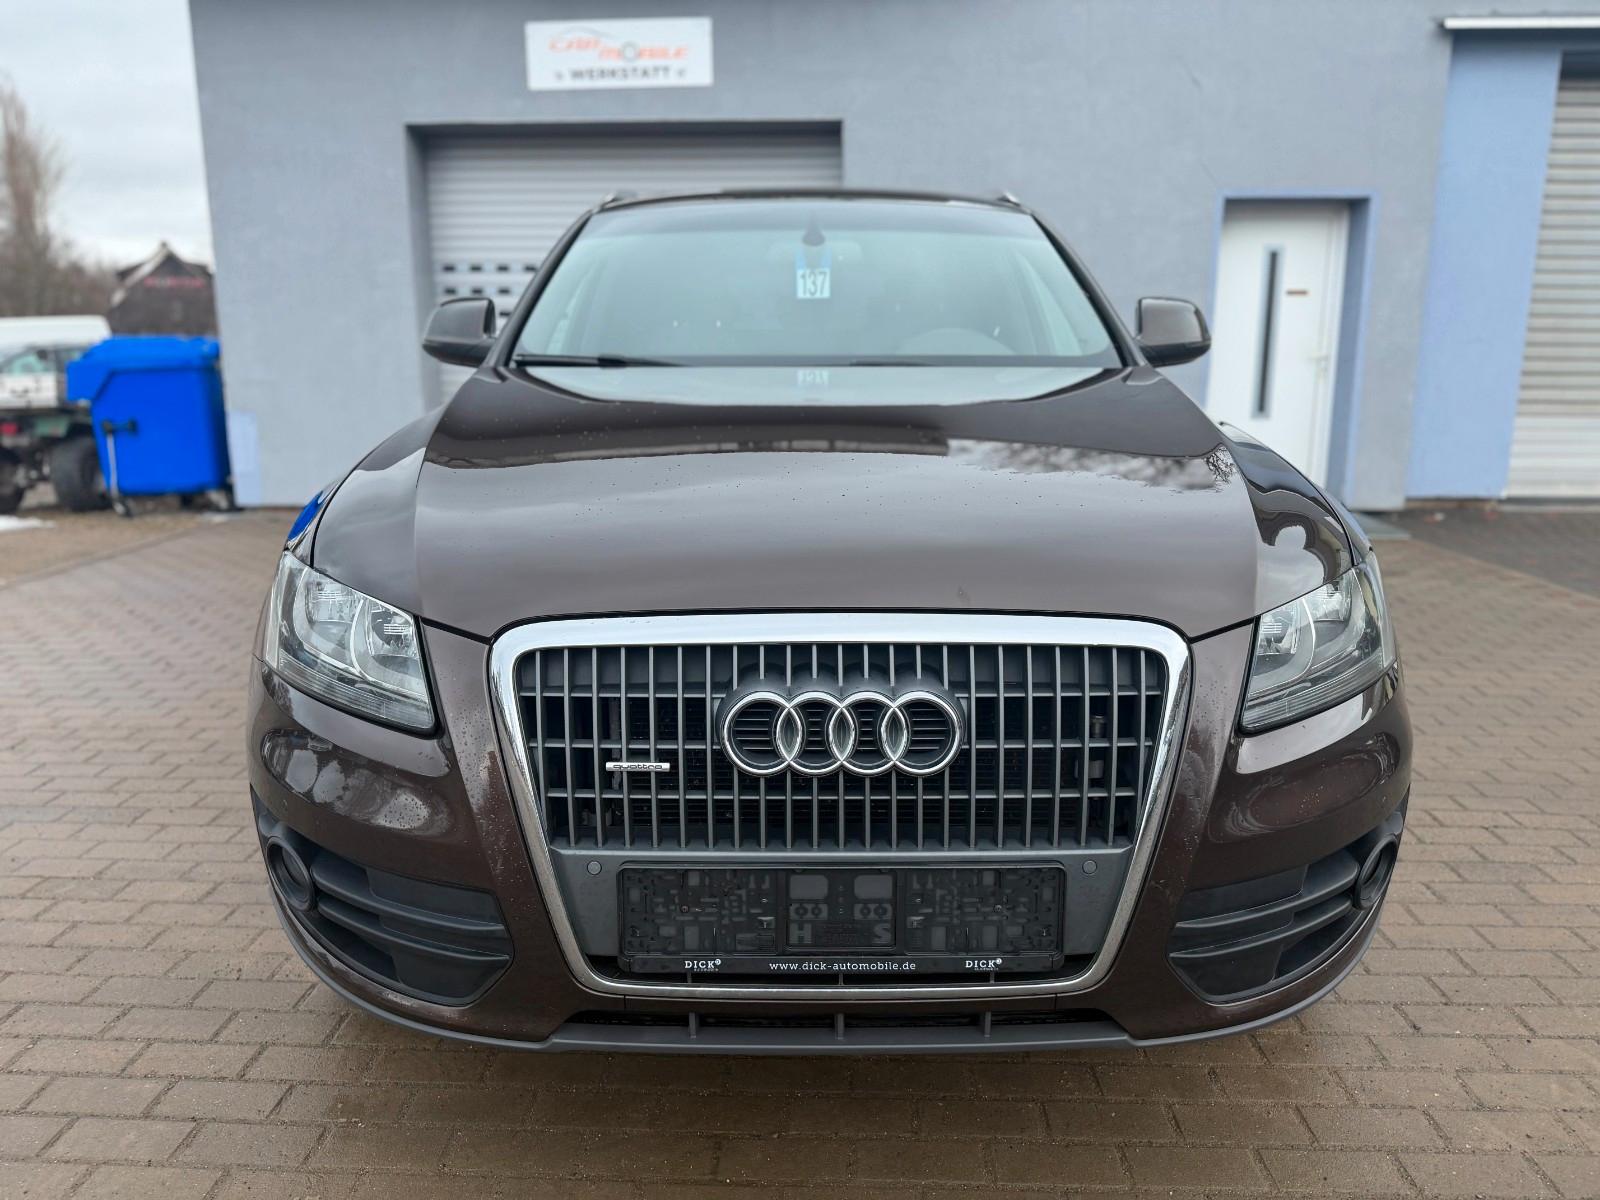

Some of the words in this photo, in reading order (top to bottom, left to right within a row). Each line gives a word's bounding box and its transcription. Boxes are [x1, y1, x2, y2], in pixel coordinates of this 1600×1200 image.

[570, 66, 672, 80] WERKSTATT
[800, 270, 827, 297] 137
[769, 961, 916, 970] www.dick-automobile.de
